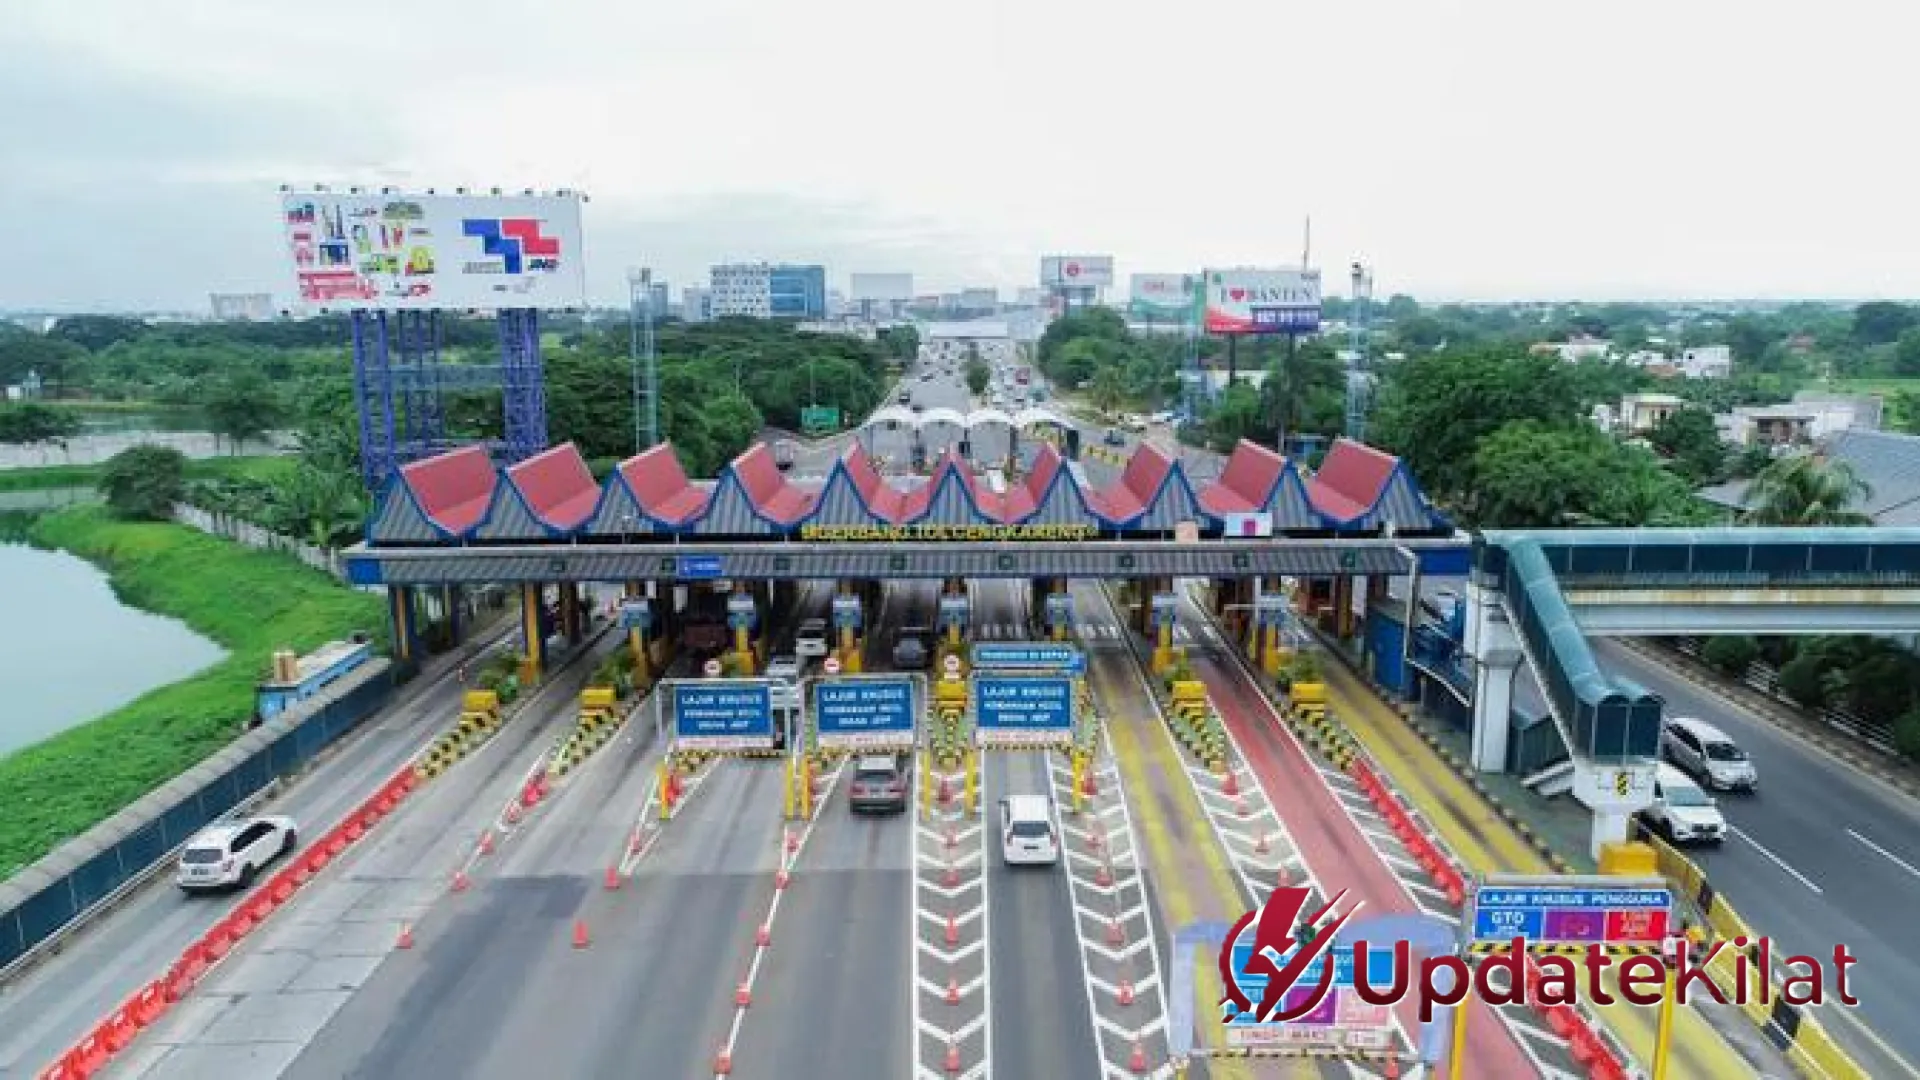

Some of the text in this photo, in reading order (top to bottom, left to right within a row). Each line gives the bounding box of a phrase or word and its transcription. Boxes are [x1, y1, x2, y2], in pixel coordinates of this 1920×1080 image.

[1481, 893, 1527, 905] LAJUR
[1531, 893, 1585, 905] KHUSUS
[1491, 911, 1525, 924] GTO
